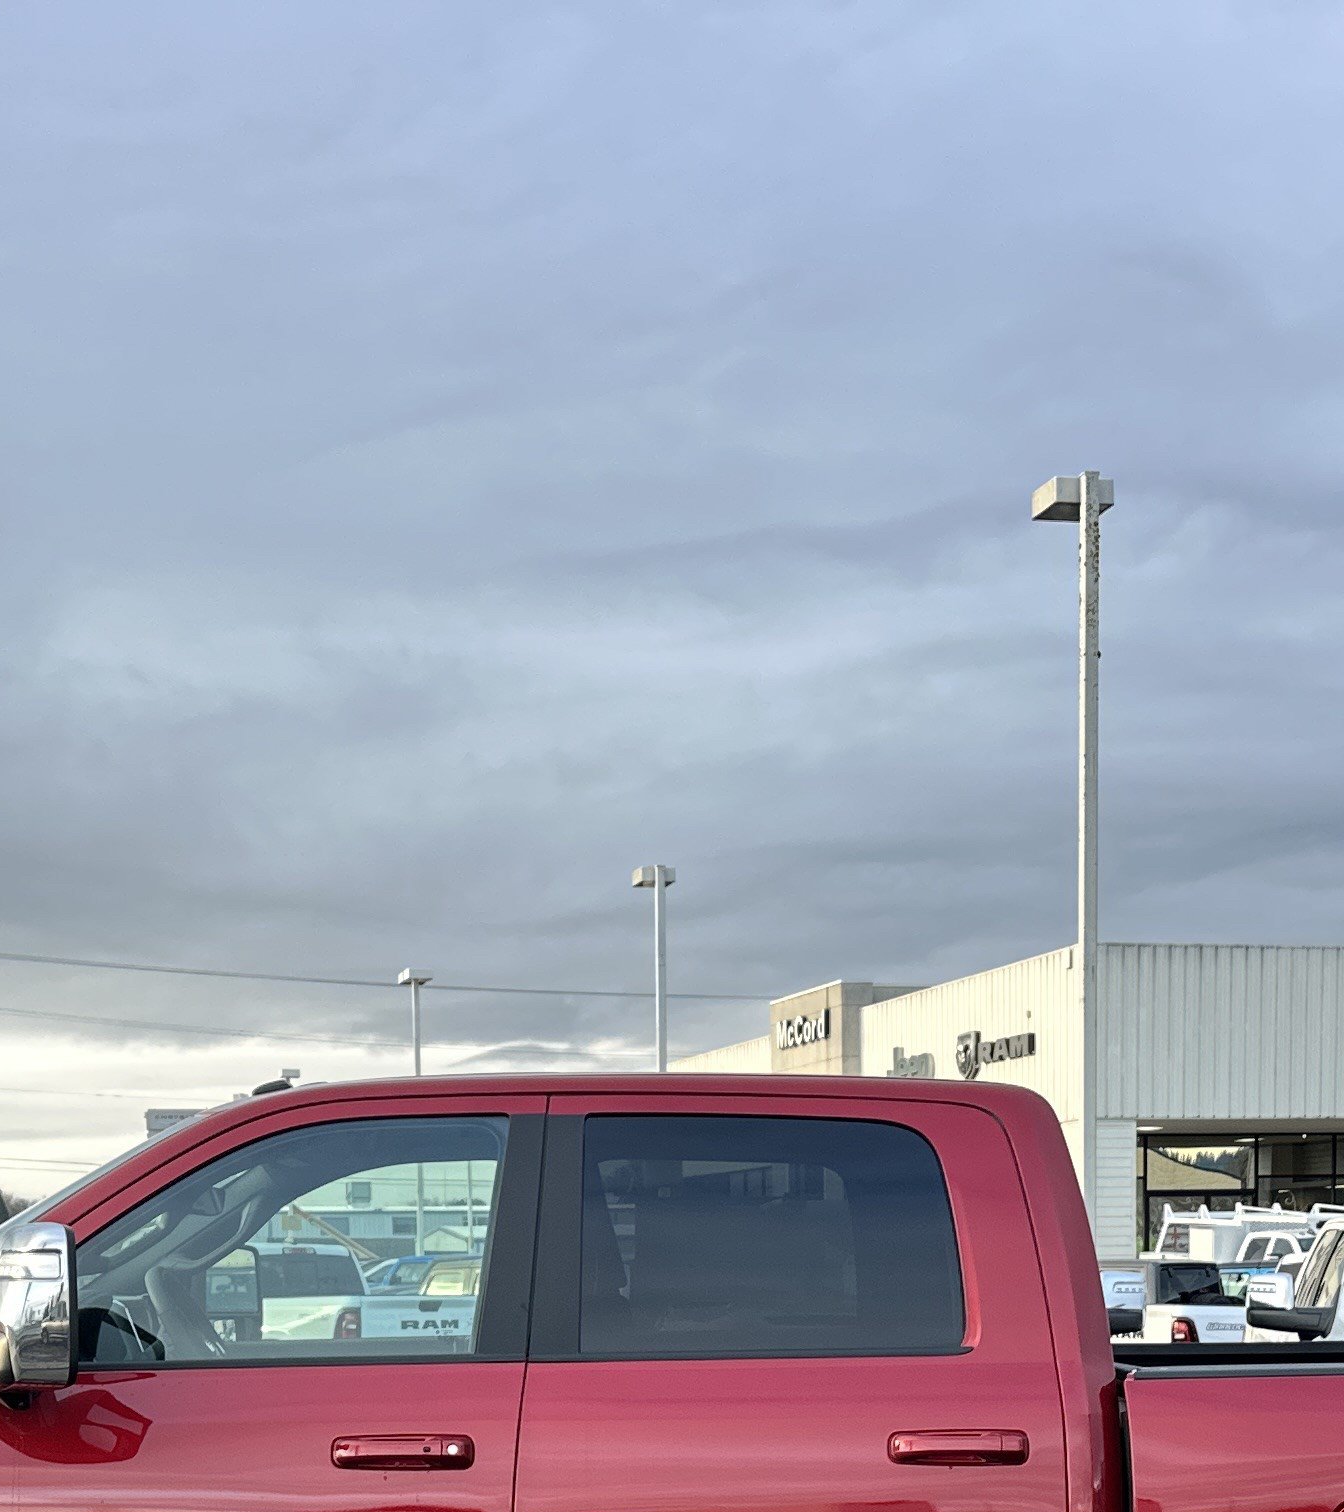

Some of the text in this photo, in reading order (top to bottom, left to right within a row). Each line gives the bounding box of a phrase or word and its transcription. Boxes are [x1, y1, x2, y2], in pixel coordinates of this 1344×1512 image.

[776, 1009, 830, 1050] McCord
[978, 1033, 1036, 1063] RAM
[401, 1319, 460, 1330] RAM
